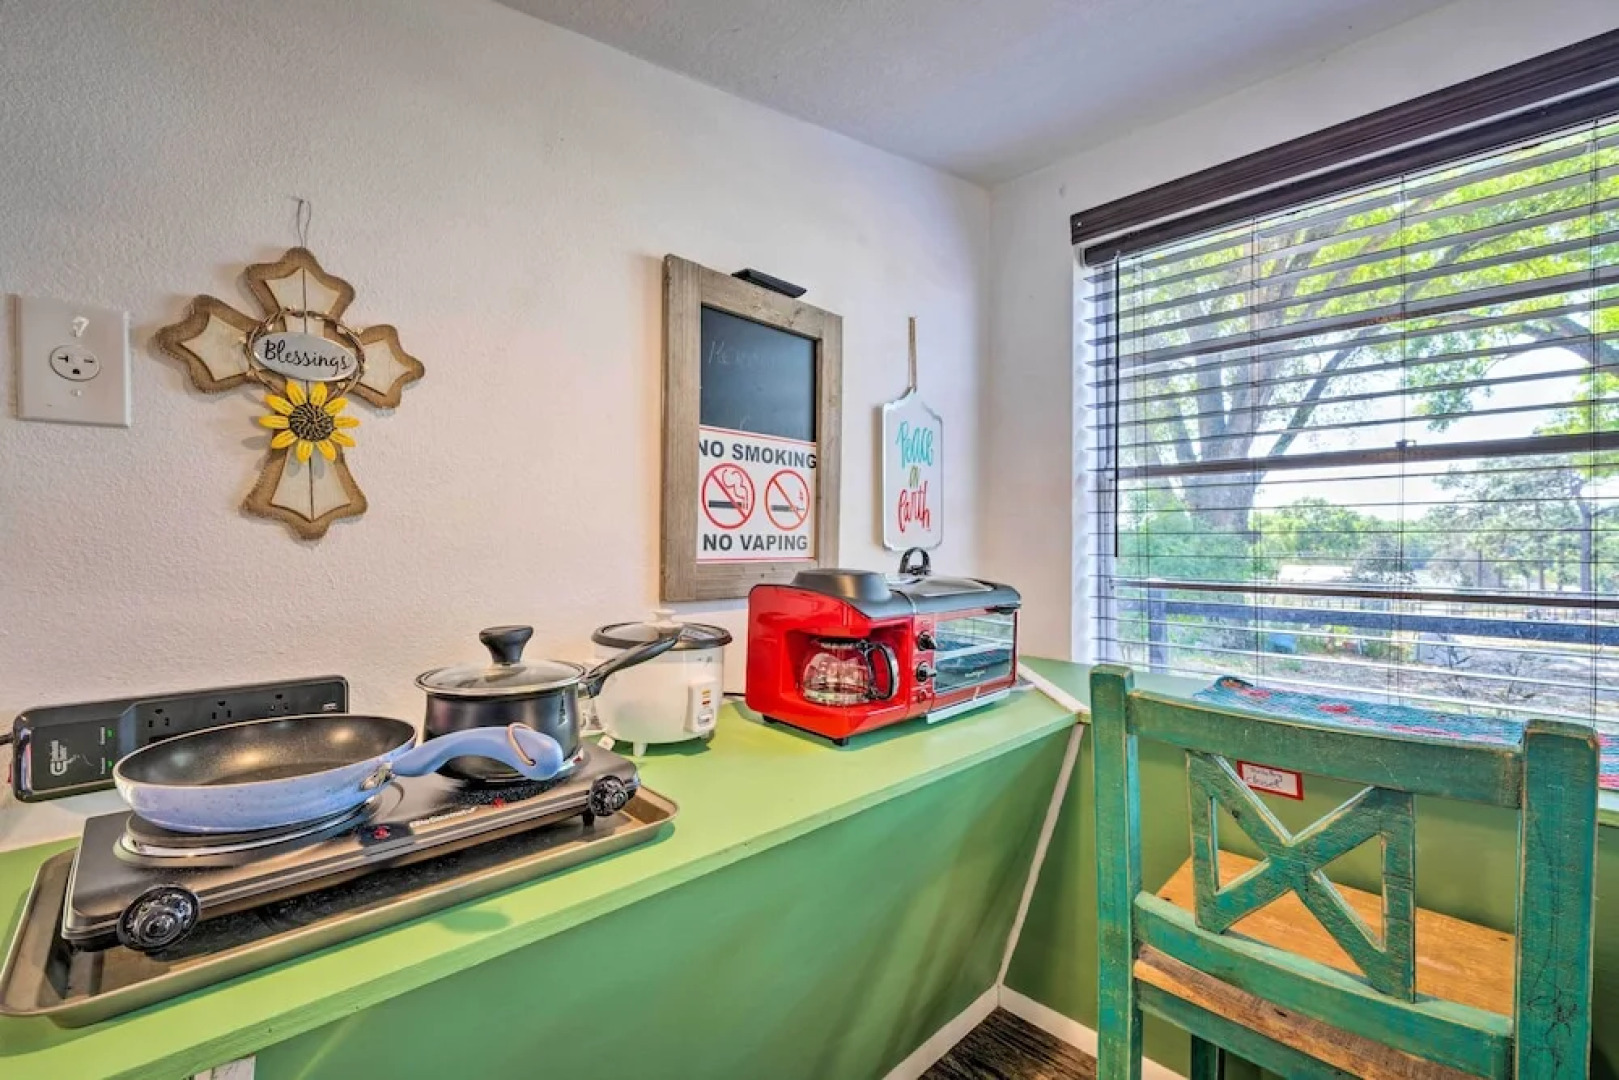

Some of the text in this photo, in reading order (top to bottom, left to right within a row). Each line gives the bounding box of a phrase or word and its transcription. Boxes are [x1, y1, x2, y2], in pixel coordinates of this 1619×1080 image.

[264, 340, 349, 378] Blessings
[699, 440, 816, 468] NO SMOKING
[896, 421, 933, 470] Peace
[898, 479, 931, 533] Earth
[703, 533, 807, 552] NO VAPING
